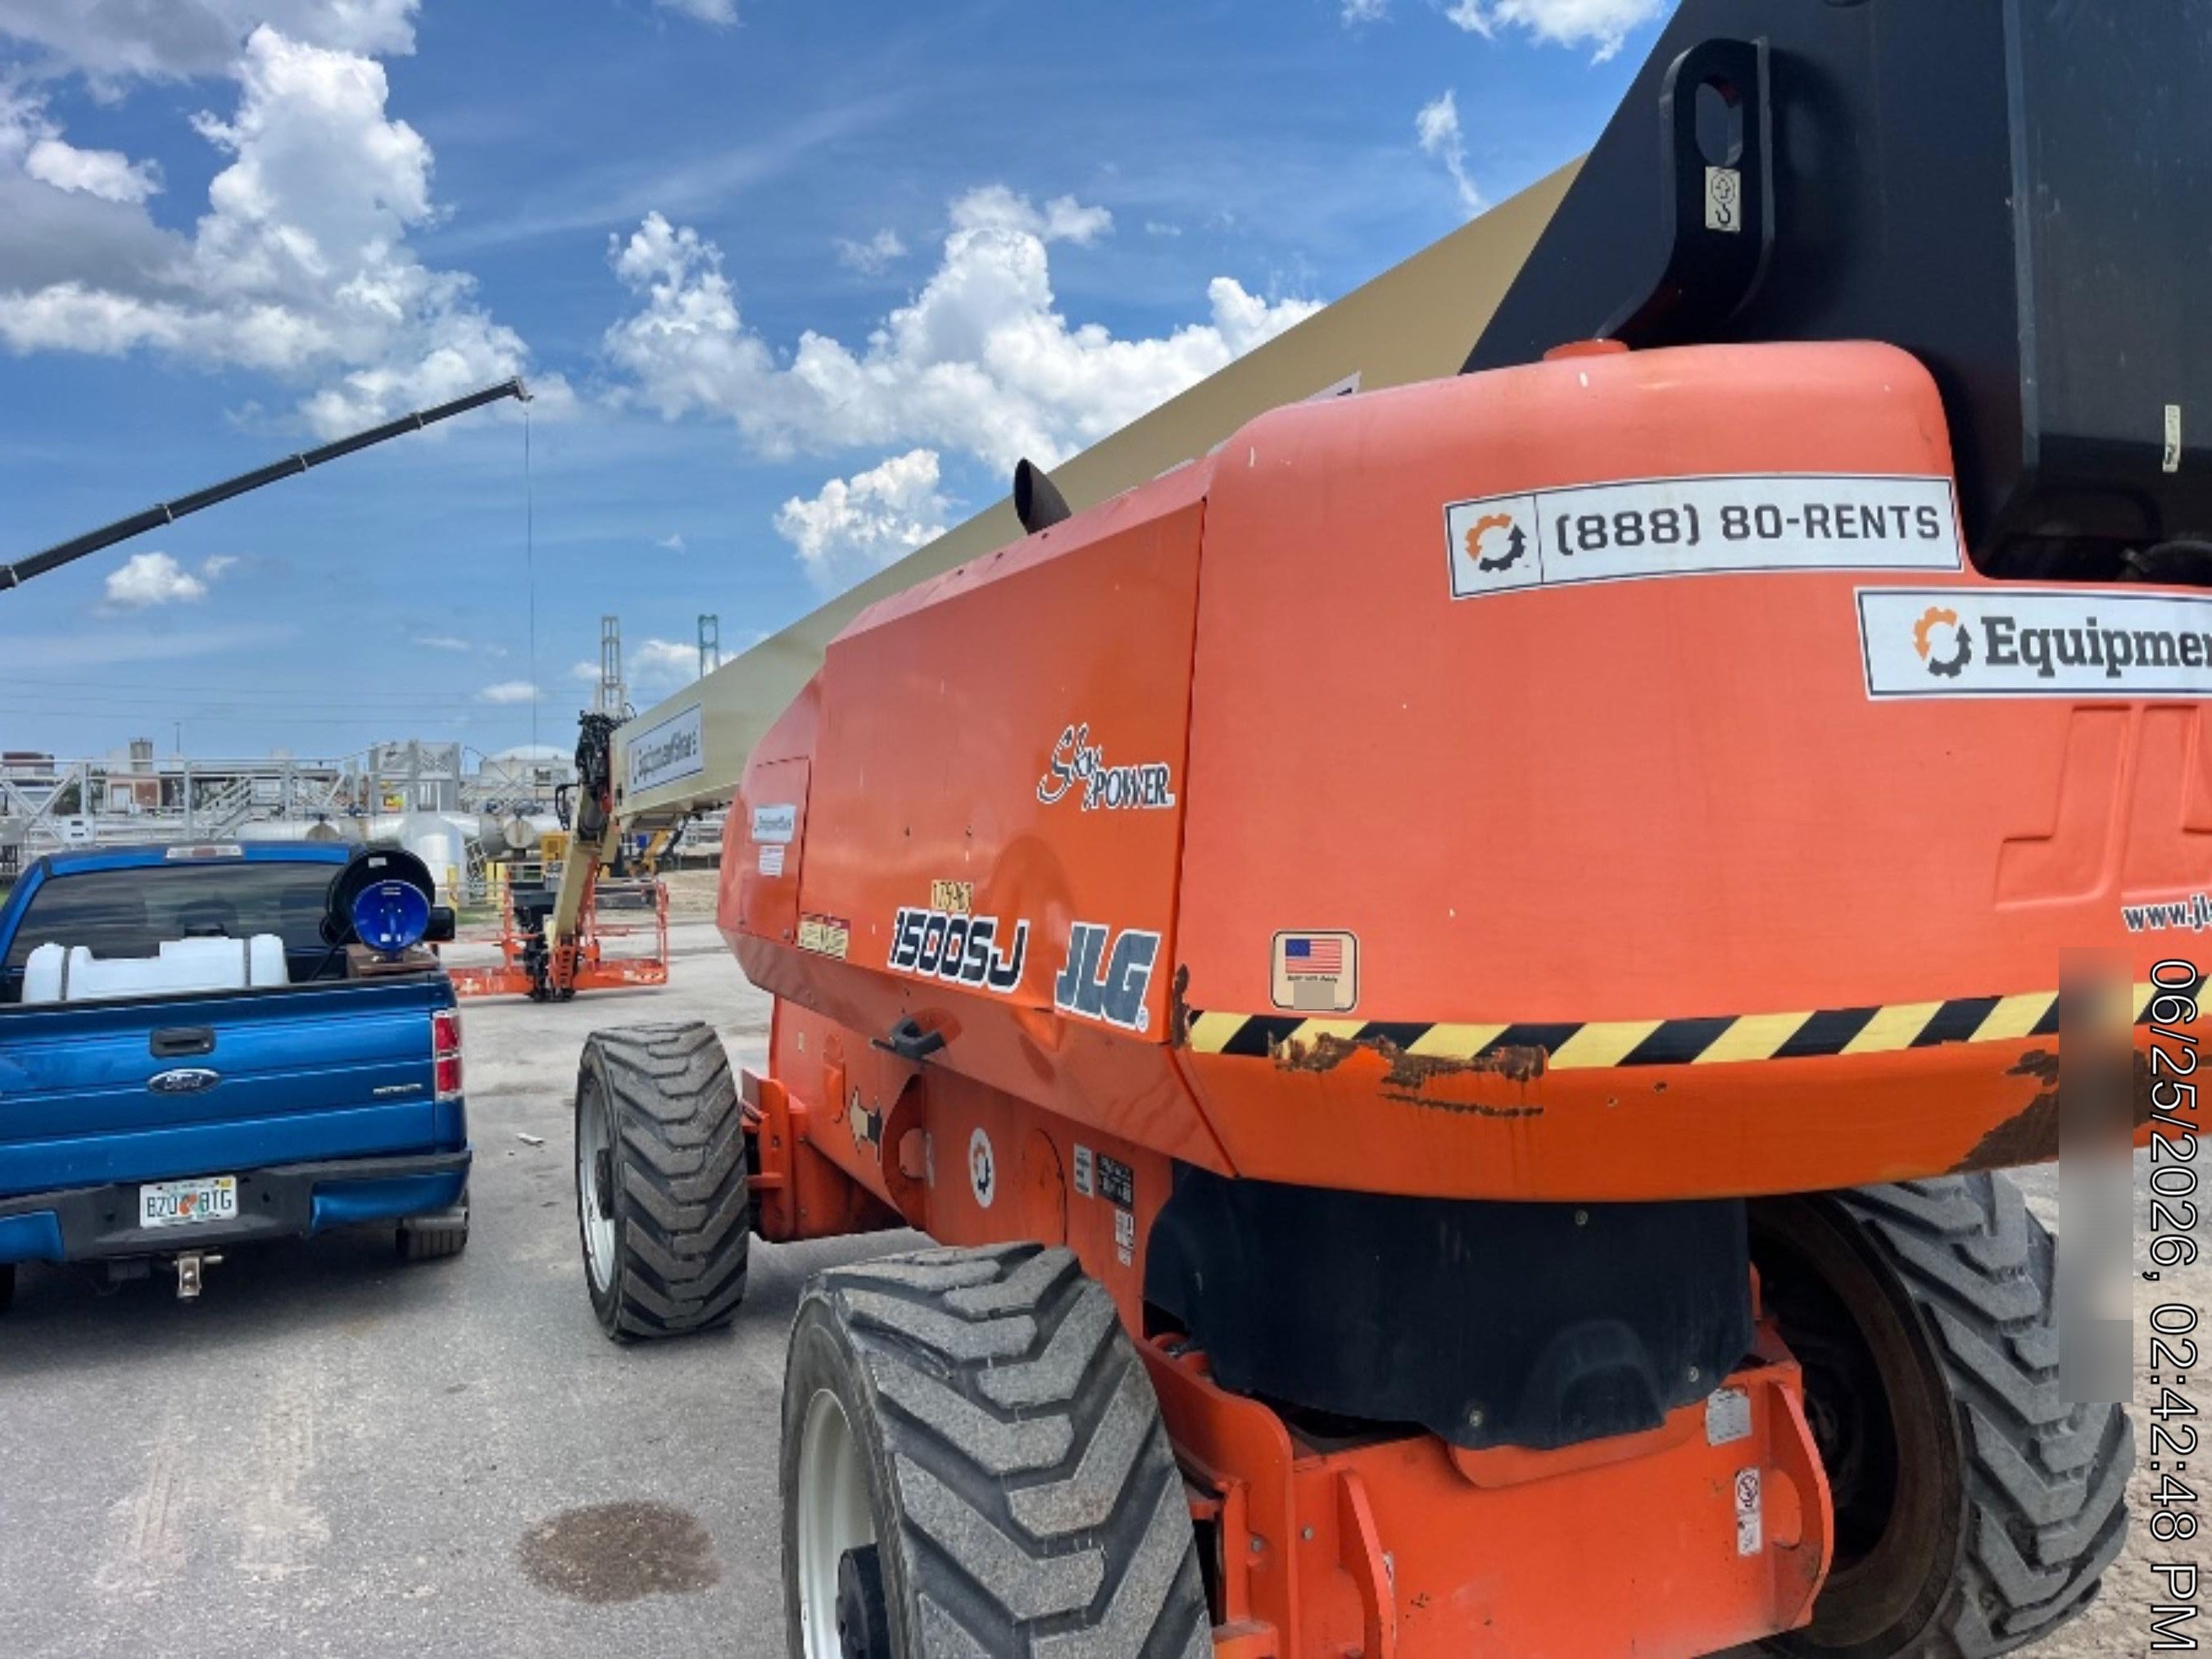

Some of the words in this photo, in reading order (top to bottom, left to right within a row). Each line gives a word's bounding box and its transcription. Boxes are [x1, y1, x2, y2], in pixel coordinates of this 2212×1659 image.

[1556, 503, 1700, 556] (888)
[1720, 503, 1941, 542] 80-RENTS
[1980, 615, 2212, 678] Equipme
[1091, 762, 1176, 809] POWER
[2120, 893, 2212, 933] www.jl
[887, 906, 1030, 994] 1500SJ
[1054, 921, 1162, 1031] JLG
